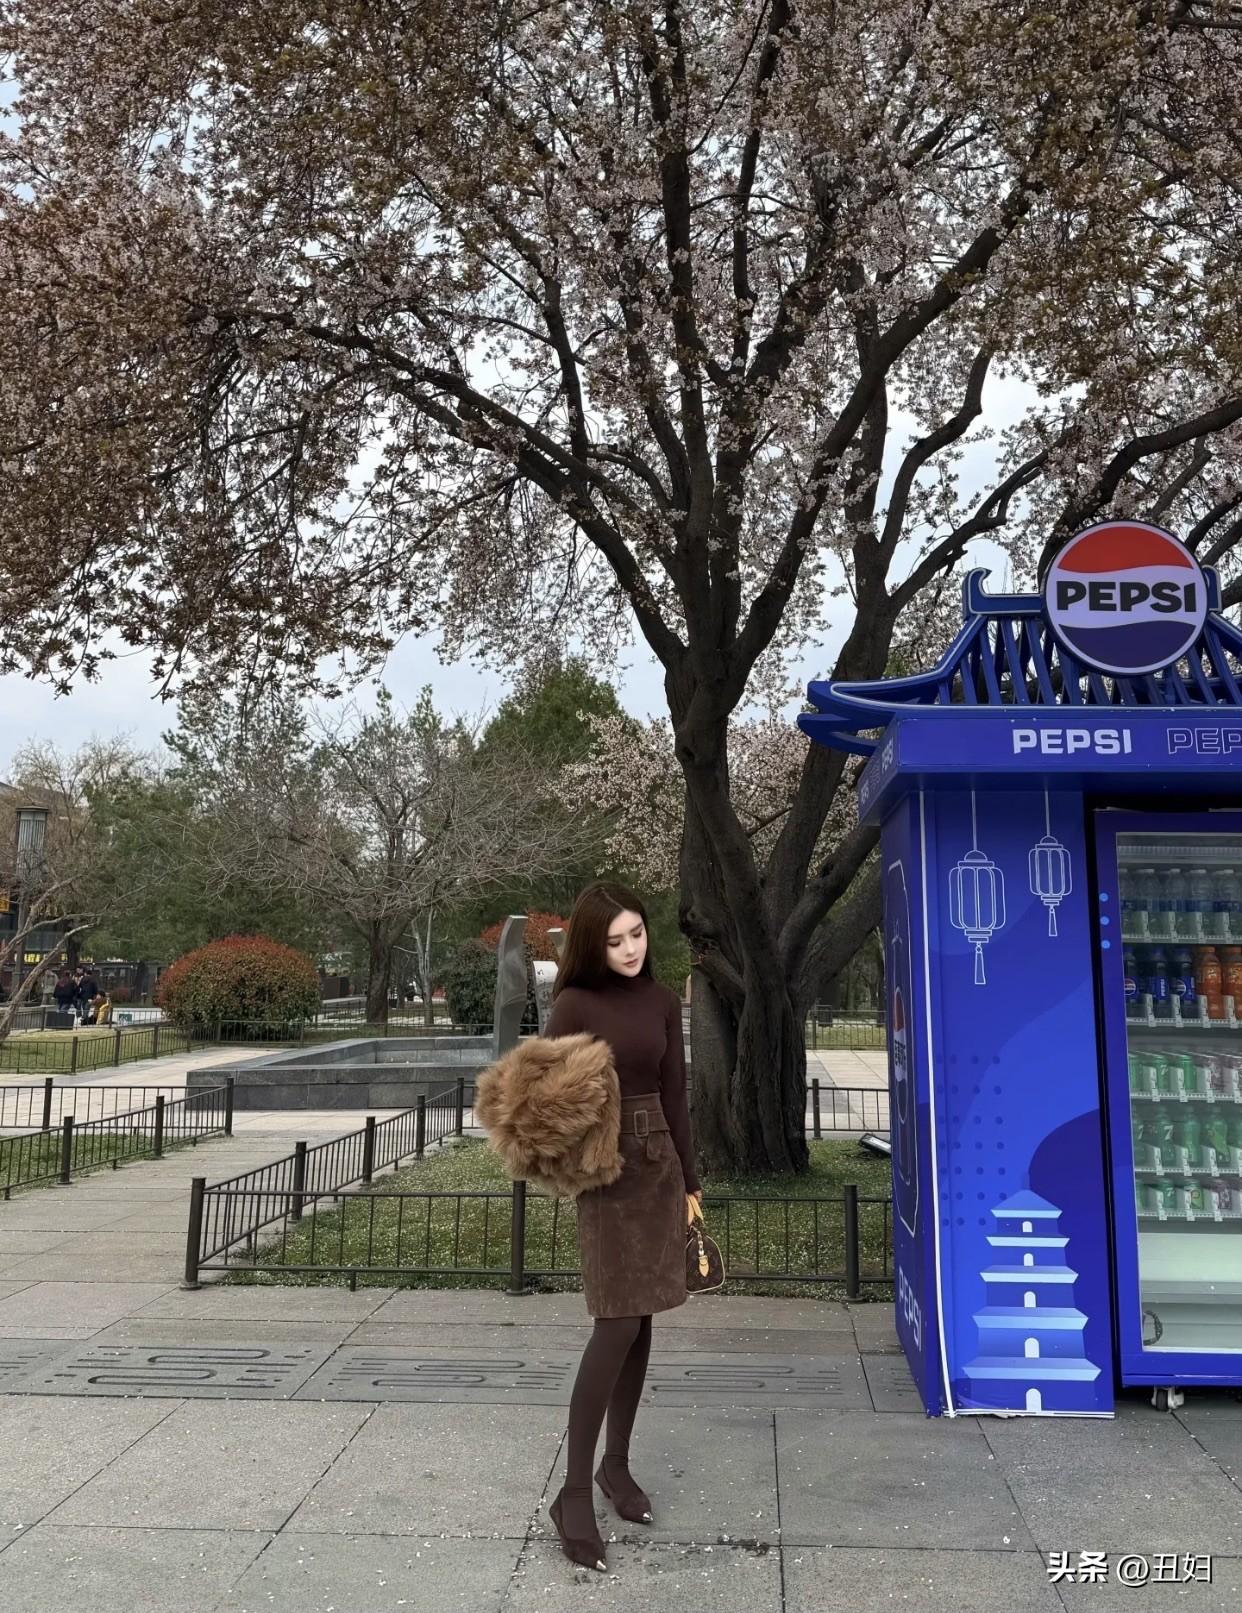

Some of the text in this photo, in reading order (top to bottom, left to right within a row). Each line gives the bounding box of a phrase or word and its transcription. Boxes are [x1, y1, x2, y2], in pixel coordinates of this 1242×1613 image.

[1056, 580, 1198, 613] PEPSI
[1012, 728, 1132, 754] PEPSI
[1163, 1124, 1174, 1140] 7
[898, 1265, 922, 1352] PEPSI
